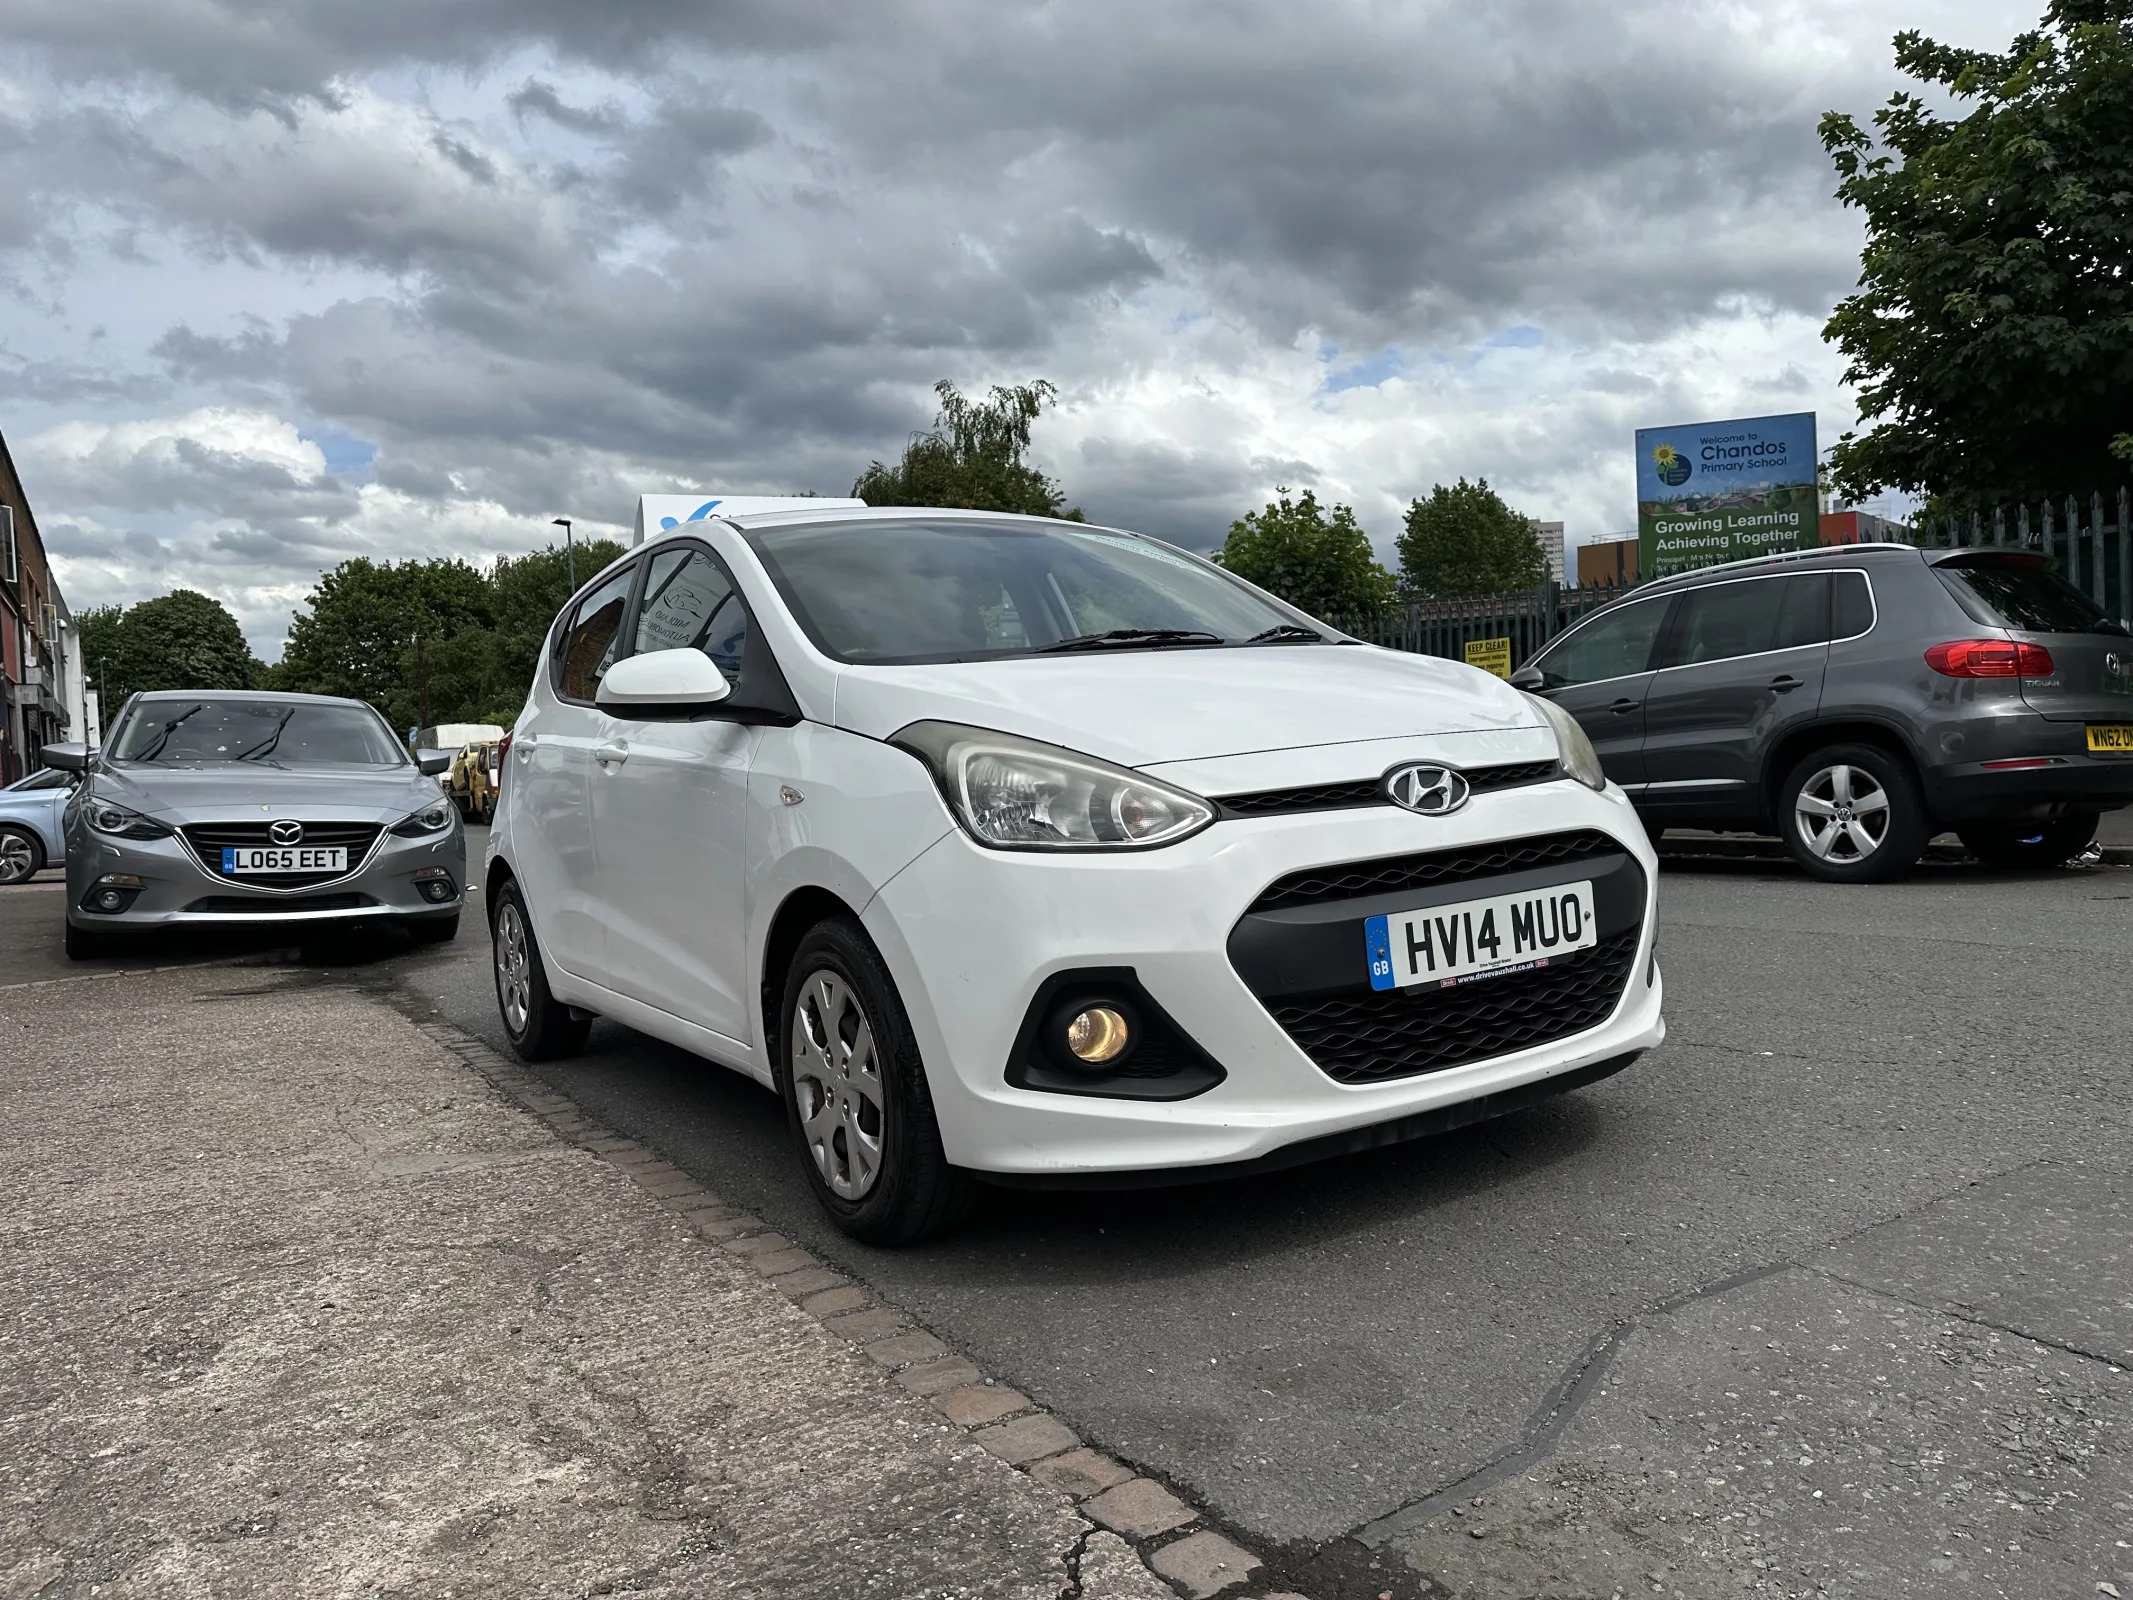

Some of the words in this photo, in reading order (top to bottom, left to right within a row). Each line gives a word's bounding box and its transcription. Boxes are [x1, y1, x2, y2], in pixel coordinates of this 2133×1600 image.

[1700, 434, 1745, 445] Welcome
[1748, 432, 1758, 441] to
[1701, 441, 1786, 460] Chandos
[1701, 462, 1744, 473] Primary
[1748, 456, 1787, 469] School
[1655, 518, 1723, 533] Growing
[1728, 511, 1799, 528] Learning
[1656, 535, 1729, 551] Achieving
[1733, 529, 1800, 545] Together
[1467, 643, 1484, 653] KEEP
[1485, 640, 1508, 651] CLEAR!
[2092, 728, 2122, 747] WN62
[236, 850, 293, 869] LO65
[299, 849, 340, 868] EET
[1373, 959, 1389, 977] GB
[1405, 908, 1501, 975] HV14
[1510, 893, 1582, 954] MUO
[1457, 962, 1535, 984] www.drivevauxhall.co.uk
